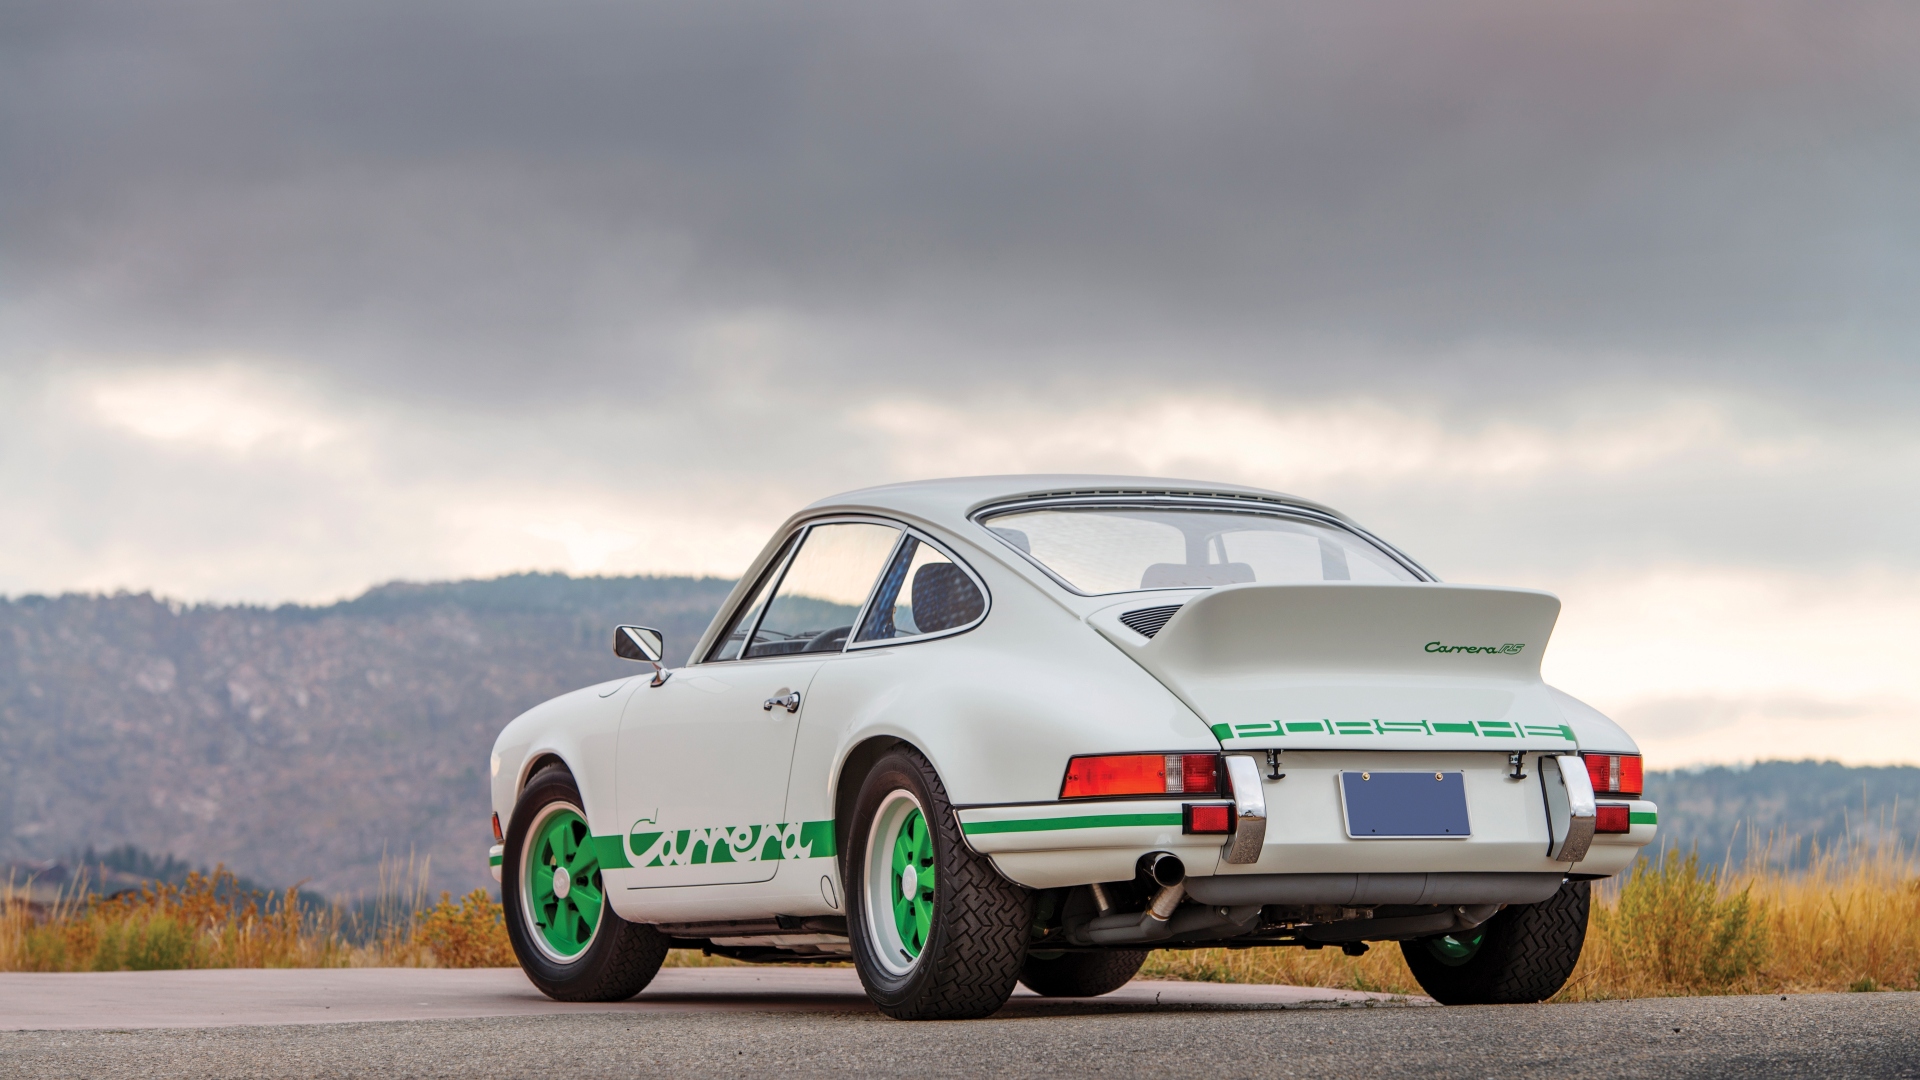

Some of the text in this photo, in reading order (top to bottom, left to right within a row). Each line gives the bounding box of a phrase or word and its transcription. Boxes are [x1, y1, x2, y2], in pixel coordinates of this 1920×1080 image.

[1424, 641, 1526, 655] Carrera RS
[1227, 718, 1567, 739] PORSCHE
[622, 808, 813, 868] Carrera
